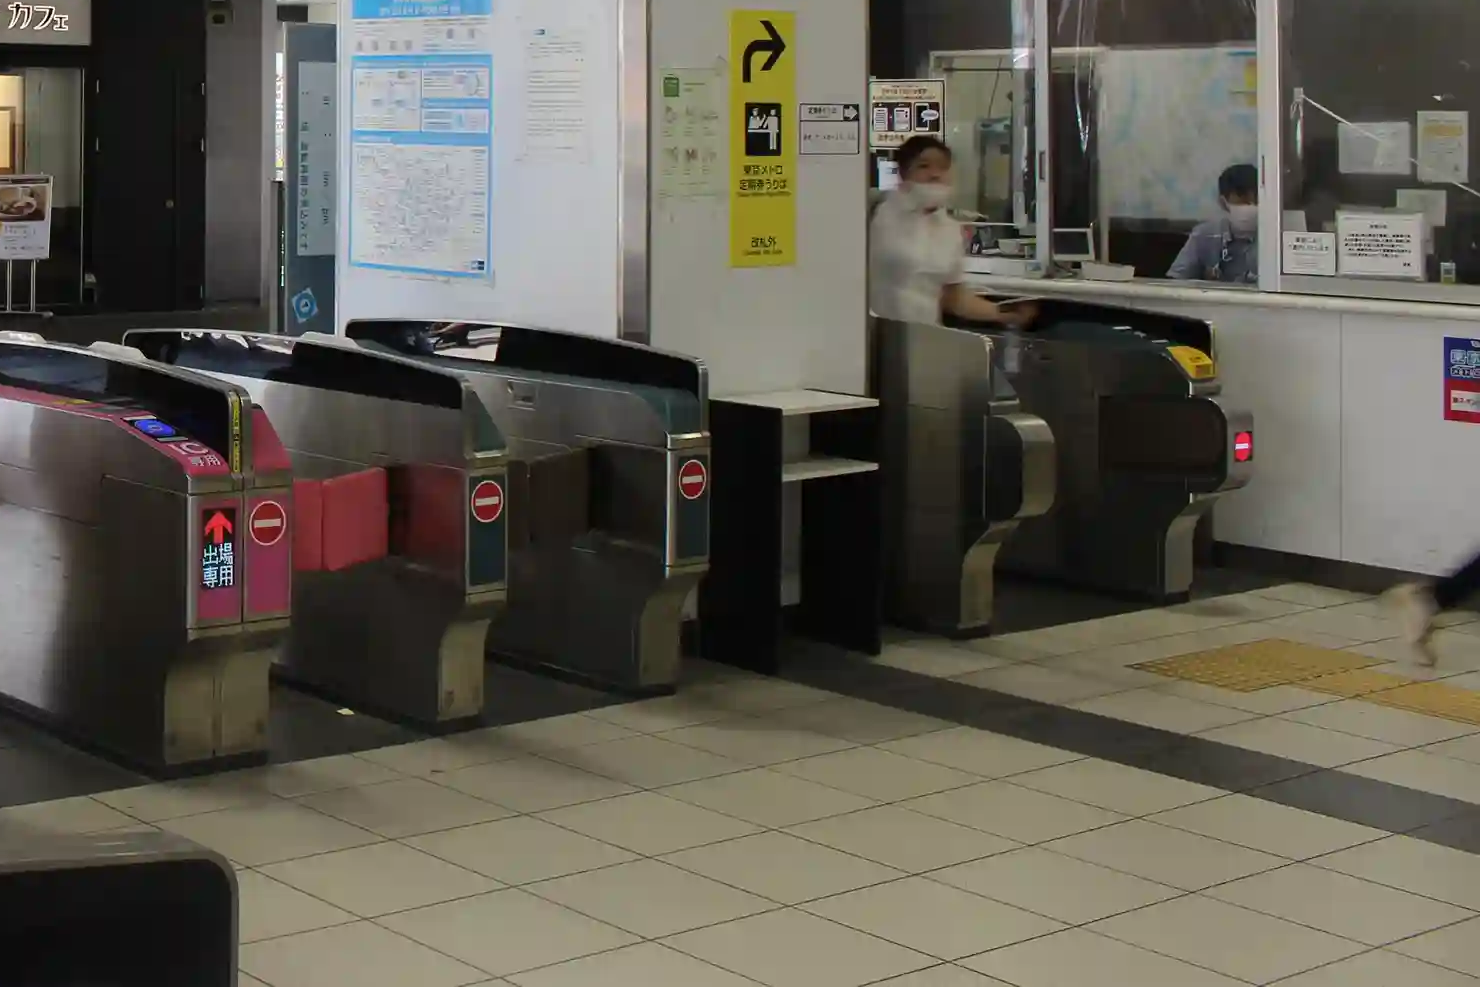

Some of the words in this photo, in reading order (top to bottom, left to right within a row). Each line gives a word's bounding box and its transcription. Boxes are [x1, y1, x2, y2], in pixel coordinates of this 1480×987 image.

[8, 1, 69, 31] カフェ
[168, 442, 209, 455] IC
[203, 542, 233, 565] 出場
[202, 565, 233, 588] 専用
